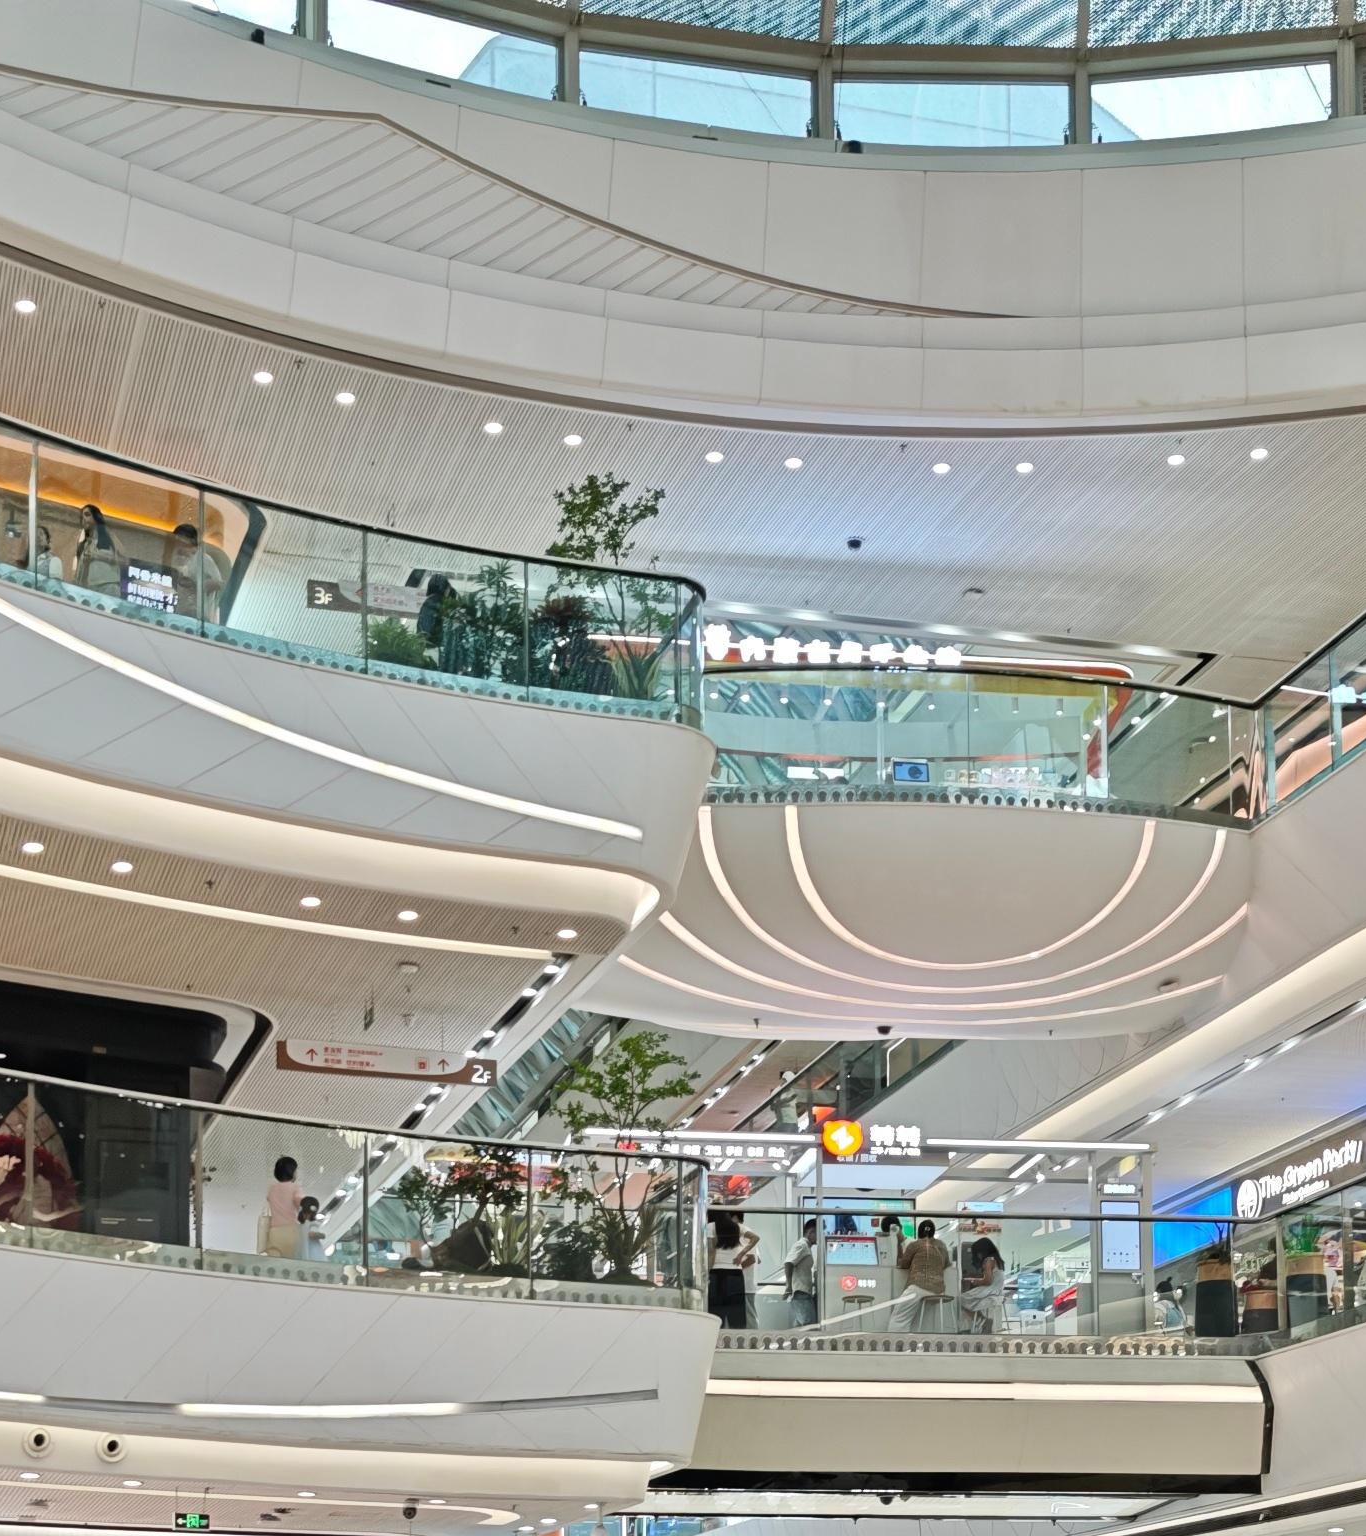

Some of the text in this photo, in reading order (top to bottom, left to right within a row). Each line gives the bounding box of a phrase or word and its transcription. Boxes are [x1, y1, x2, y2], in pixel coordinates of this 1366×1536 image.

[314, 587, 333, 605] 3F
[471, 1065, 491, 1083] 2F
[1259, 1174, 1283, 1199] The
[1282, 1157, 1323, 1193] Green
